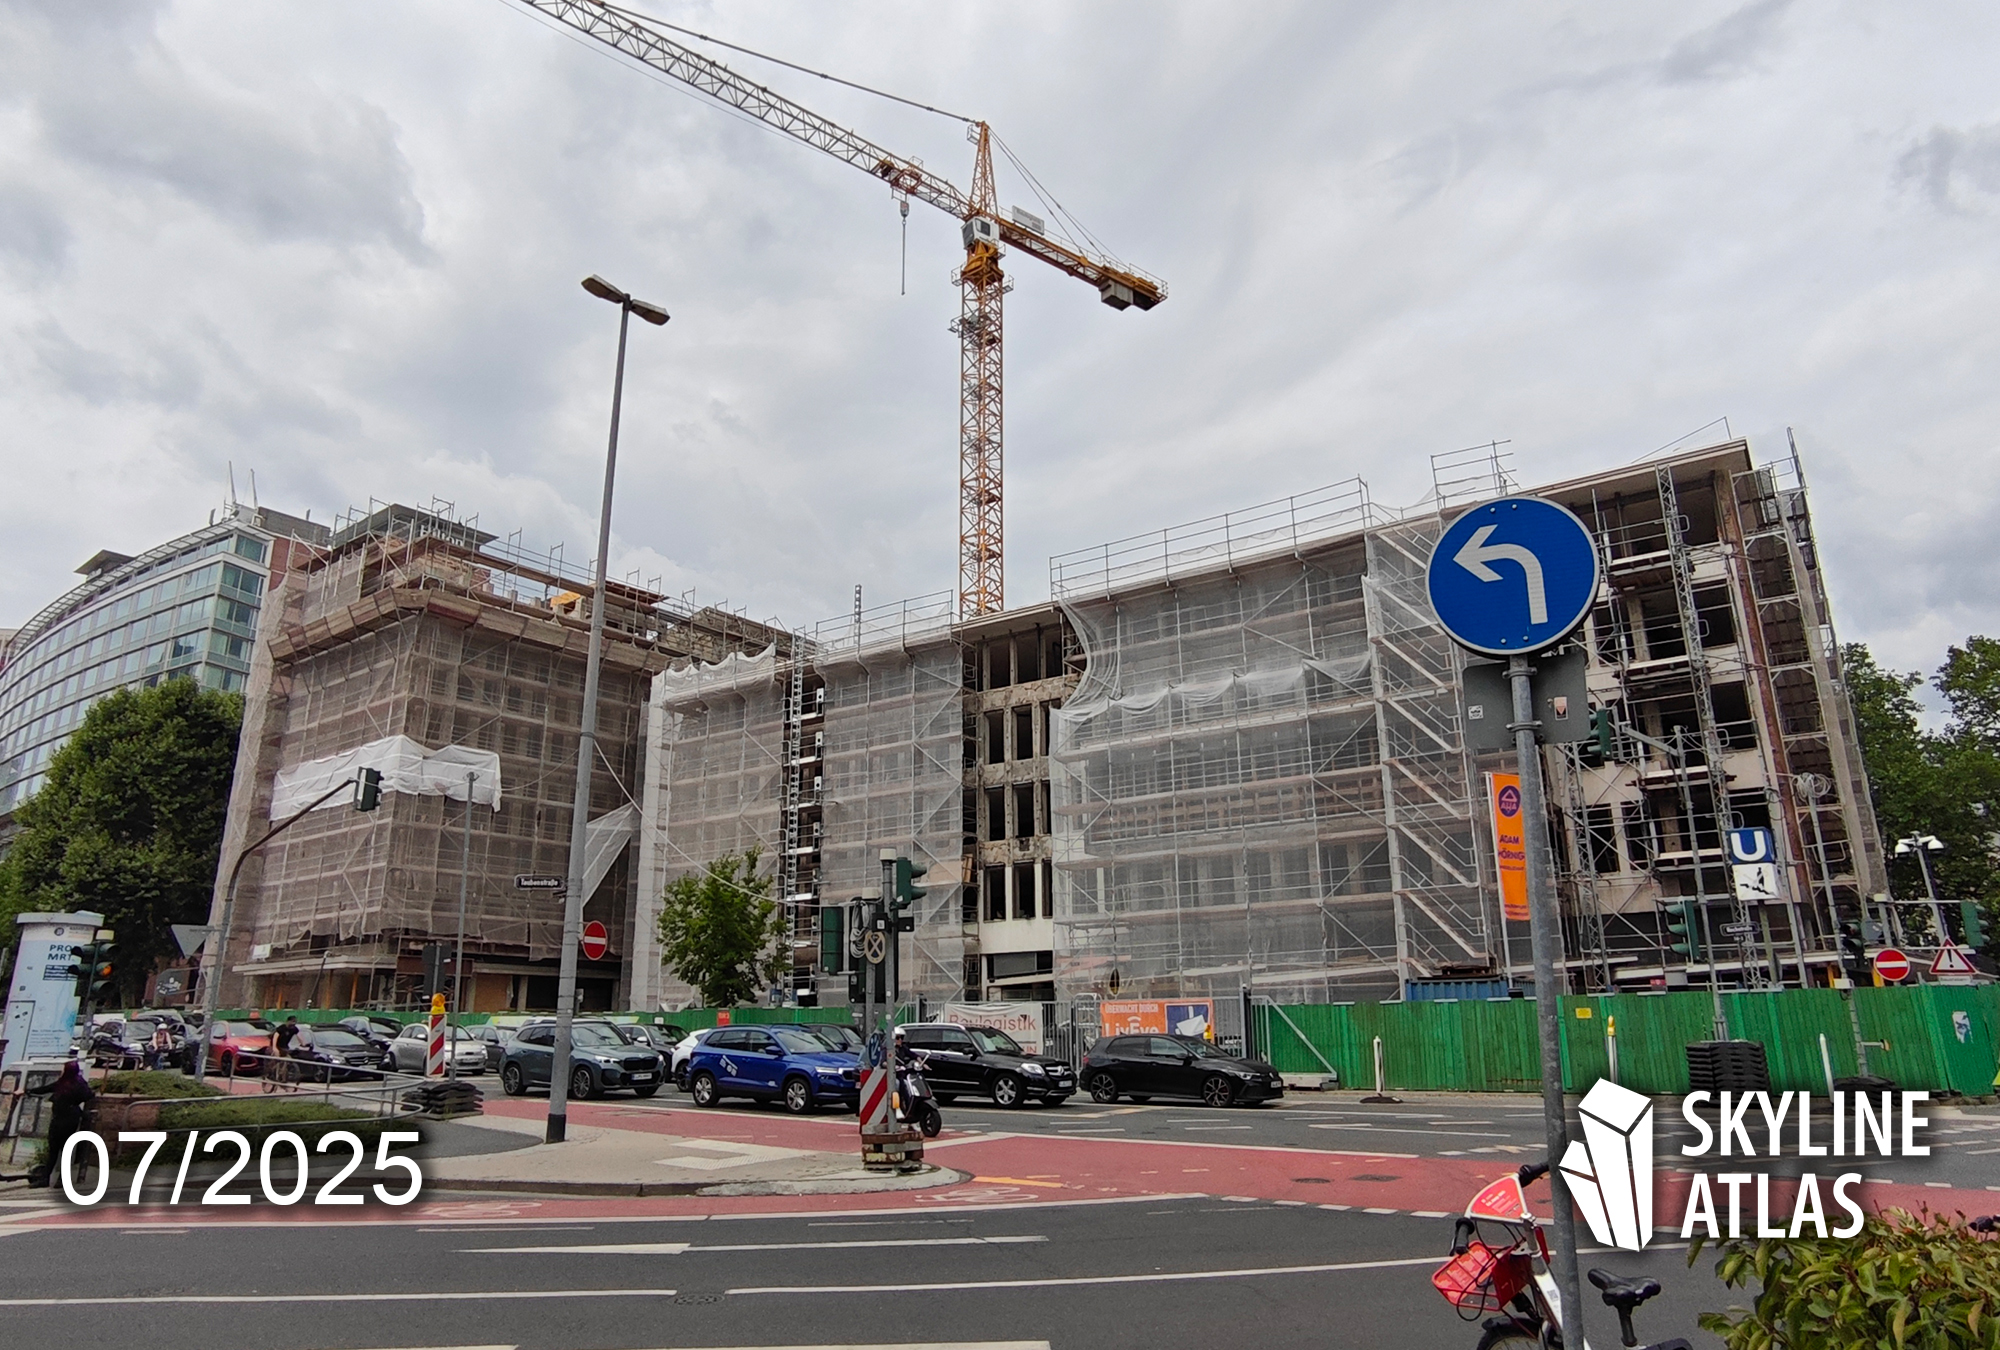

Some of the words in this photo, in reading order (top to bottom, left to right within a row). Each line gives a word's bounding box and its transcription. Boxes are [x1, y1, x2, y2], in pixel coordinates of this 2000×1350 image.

[1499, 834, 1520, 845] ADAM
[1730, 830, 1766, 862] U
[520, 878, 559, 887] Taubenstraße
[1105, 1003, 1138, 1013] ÜBERWACHT
[1139, 1003, 1159, 1012] DURCH
